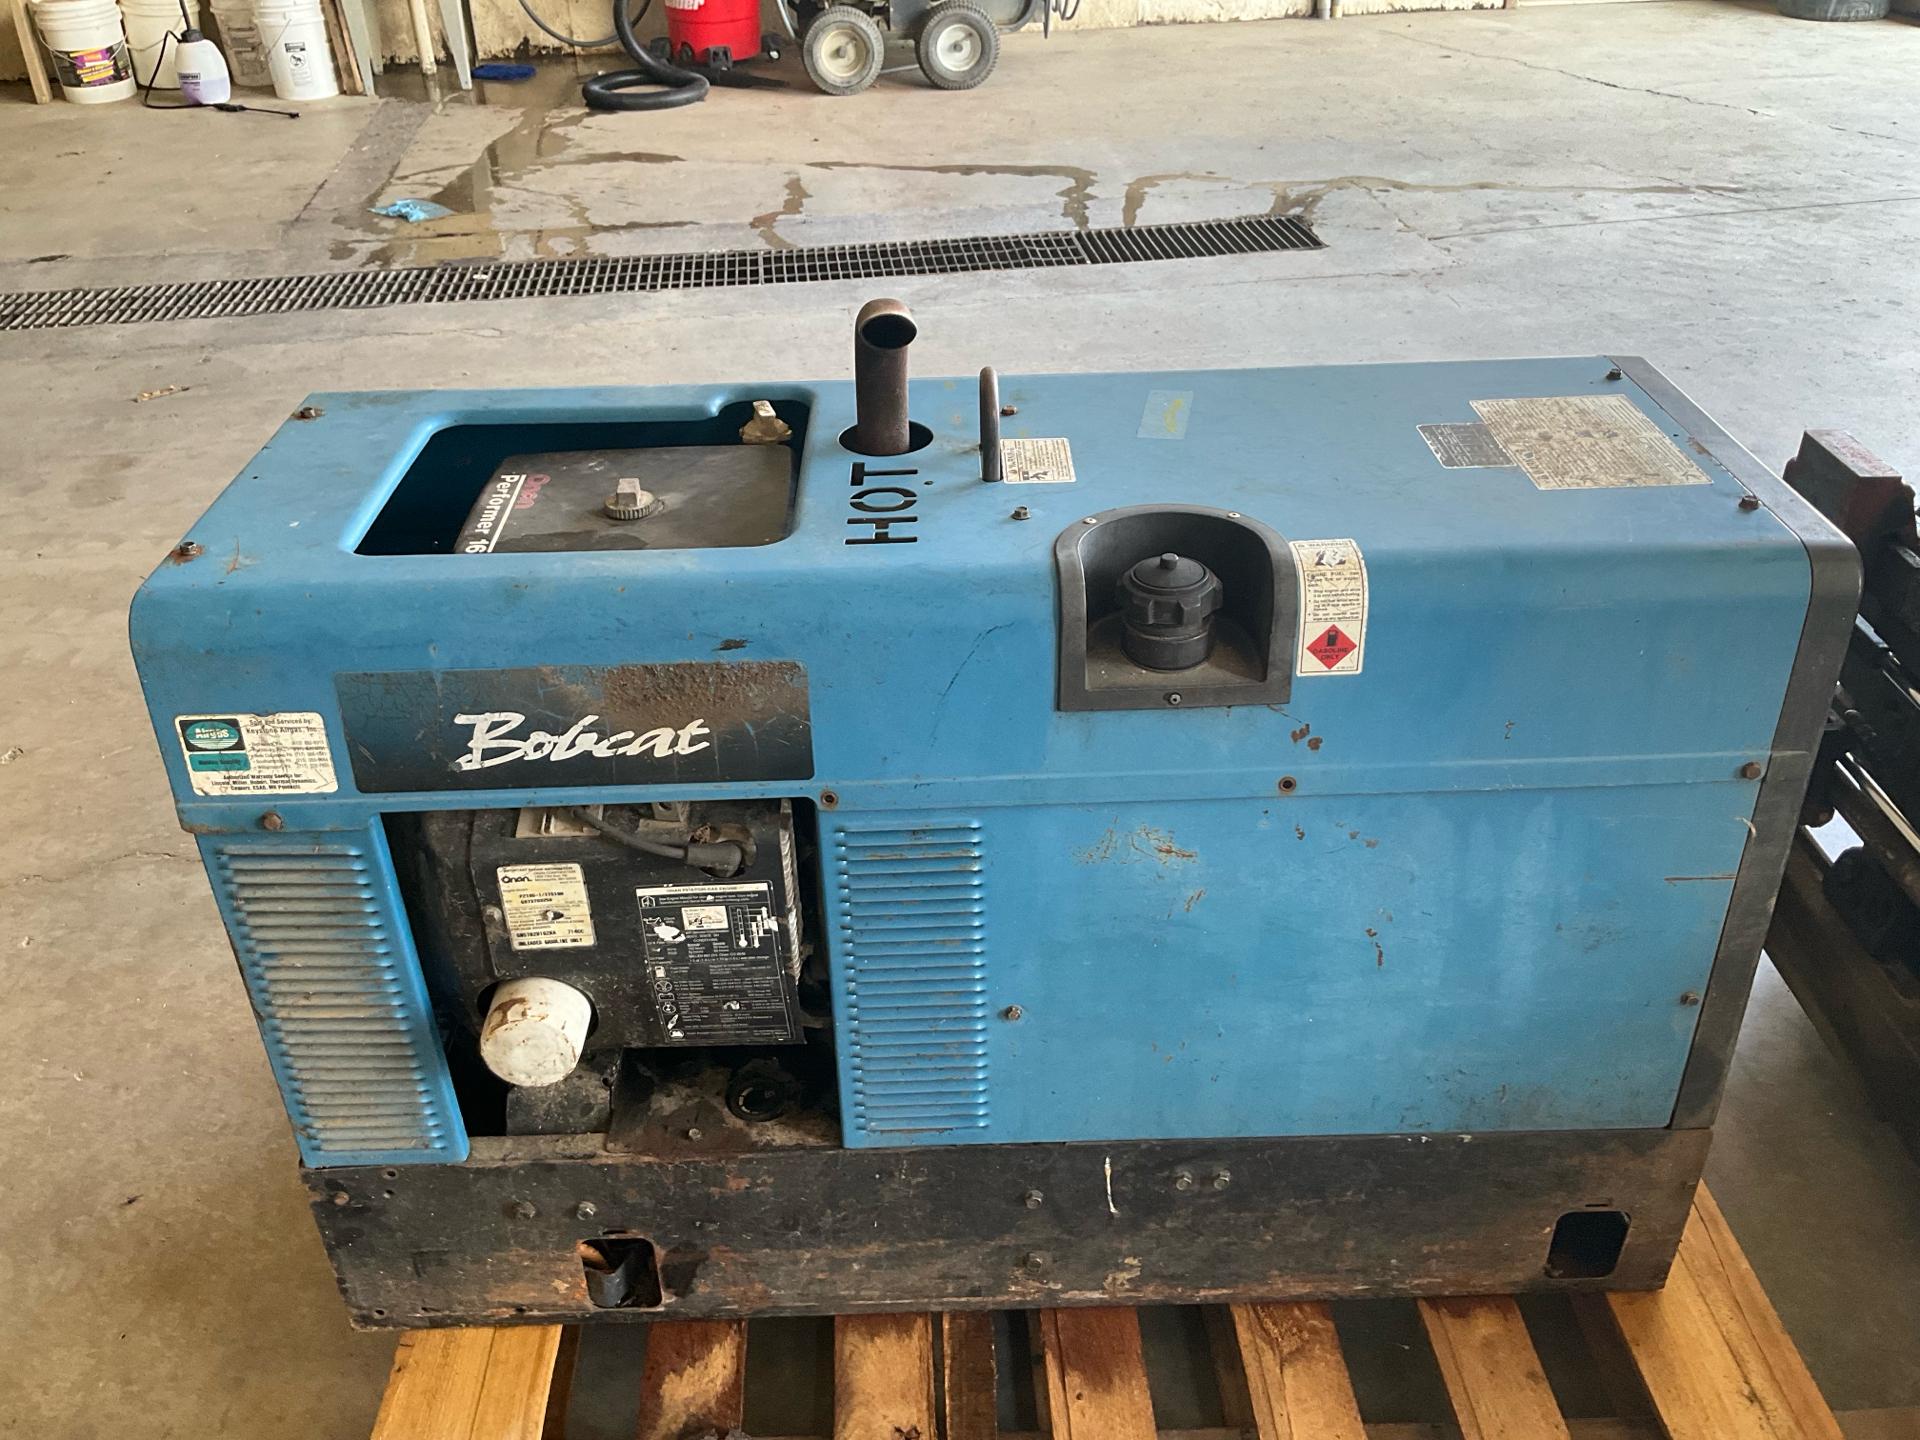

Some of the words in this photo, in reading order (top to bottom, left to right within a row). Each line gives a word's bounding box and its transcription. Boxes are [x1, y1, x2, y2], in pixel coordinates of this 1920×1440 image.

[474, 474, 520, 535] Performer
[845, 462, 918, 545] HOT
[465, 539, 489, 553] 16
[452, 711, 711, 771] Bobcat
[501, 875, 533, 883] Onan
